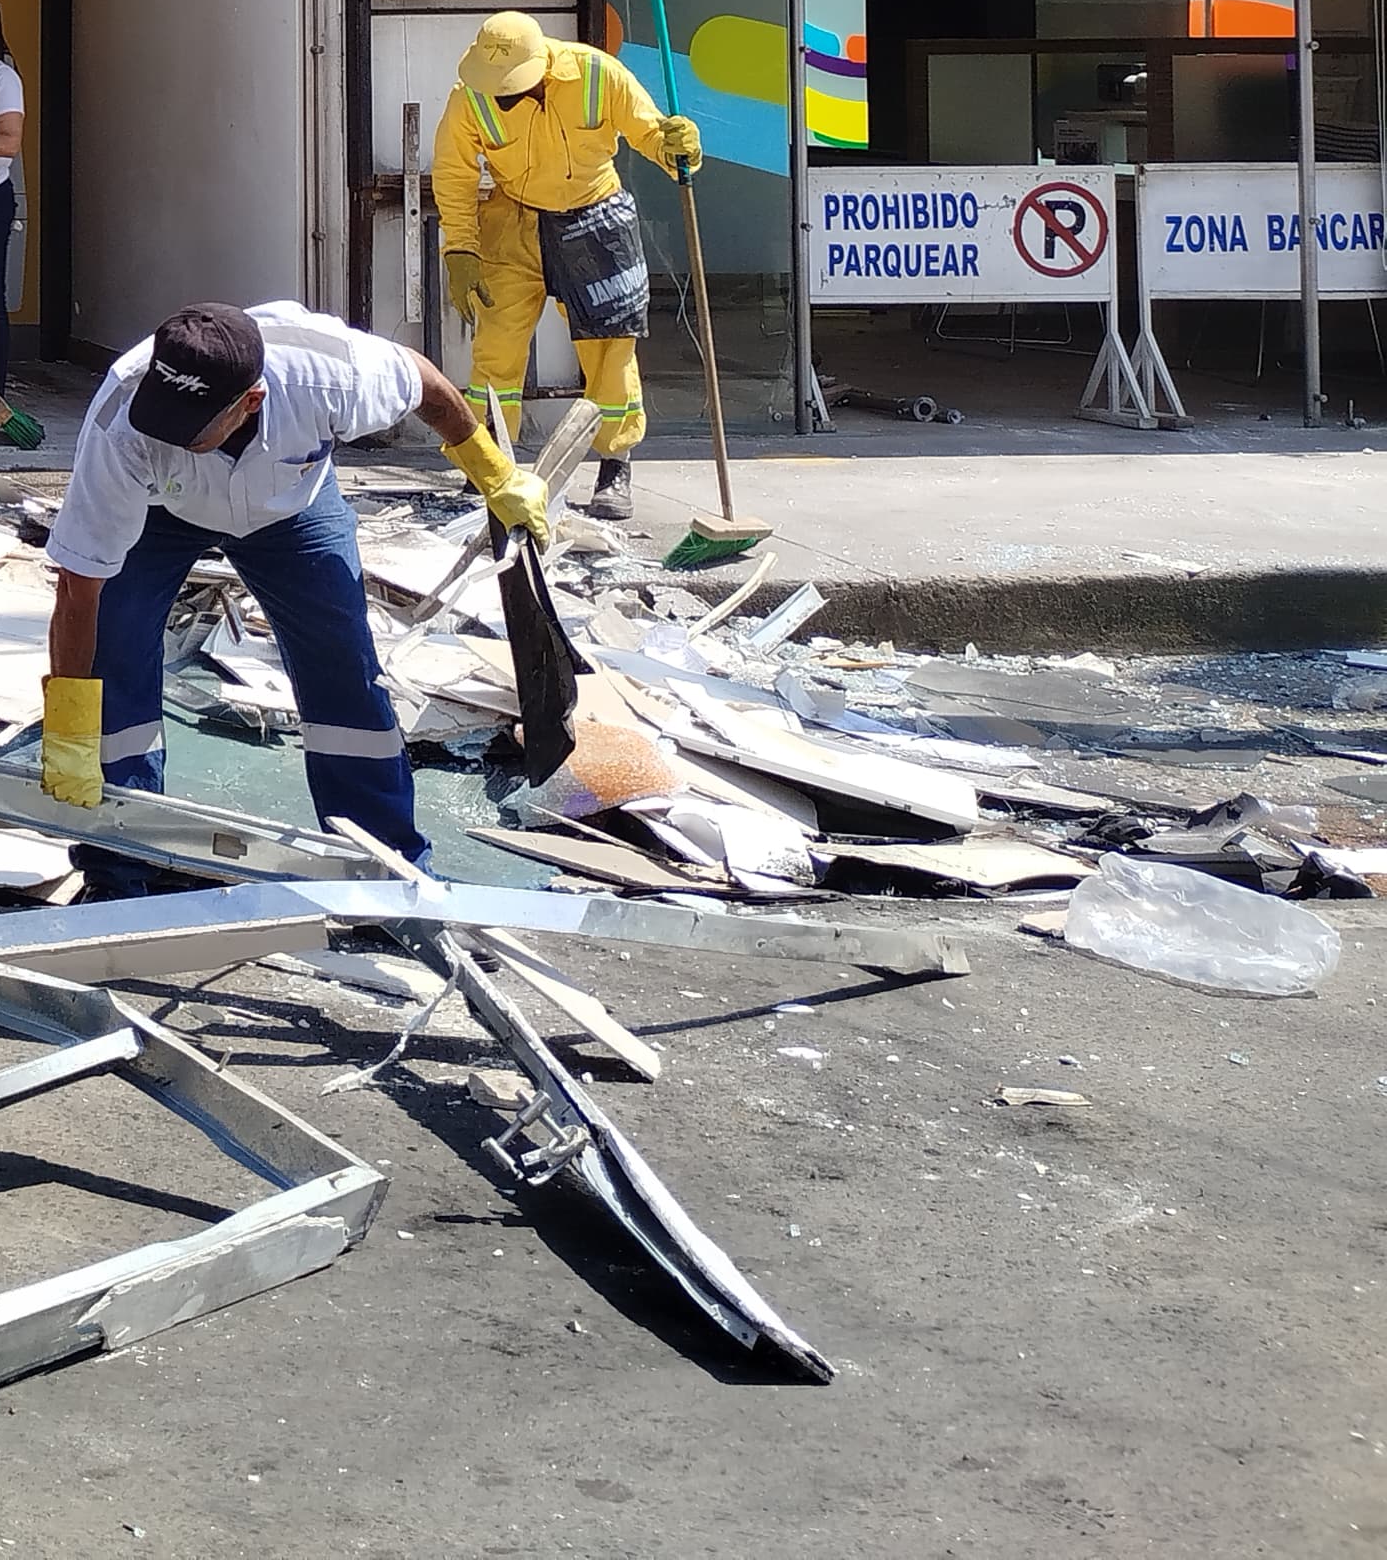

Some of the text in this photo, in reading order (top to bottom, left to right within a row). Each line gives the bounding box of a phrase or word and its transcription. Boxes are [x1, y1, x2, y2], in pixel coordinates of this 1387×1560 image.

[824, 192, 979, 230] PROHIBIDO
[1165, 215, 1249, 252] ZONA
[829, 243, 980, 279] PARQUEAR
